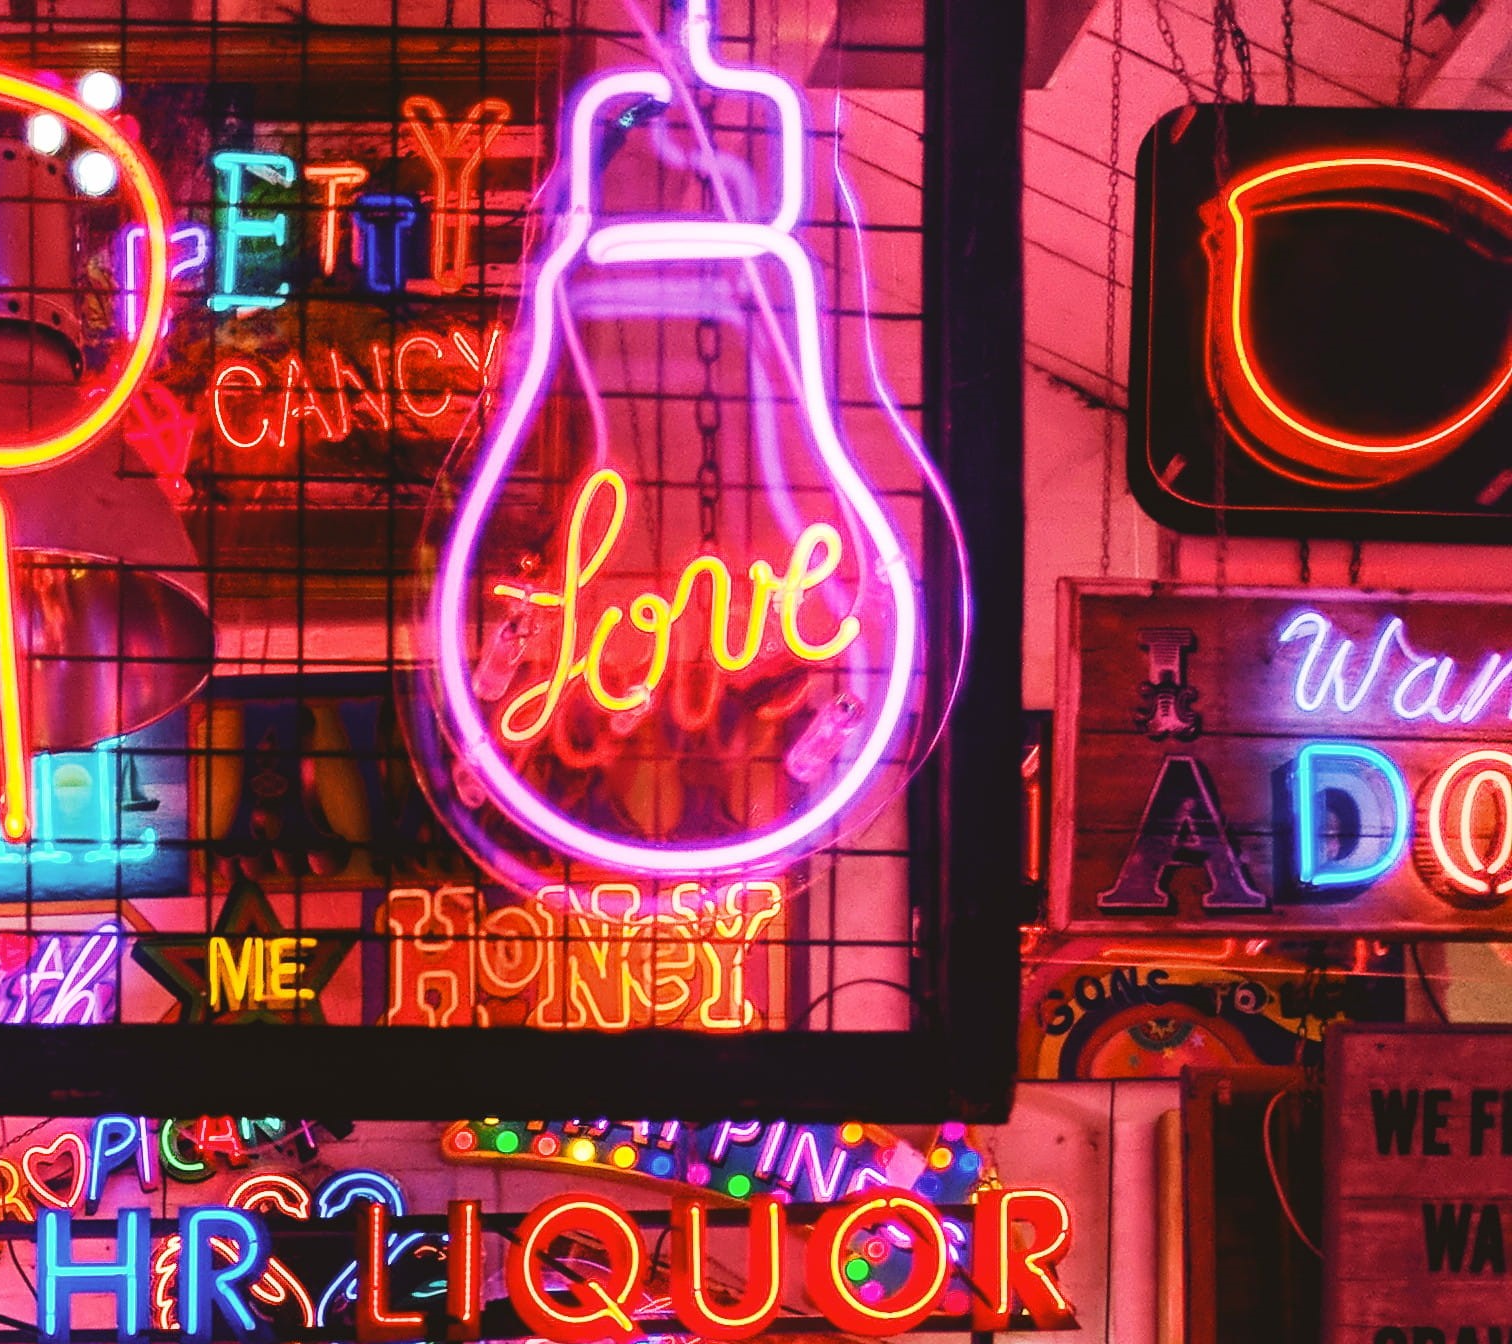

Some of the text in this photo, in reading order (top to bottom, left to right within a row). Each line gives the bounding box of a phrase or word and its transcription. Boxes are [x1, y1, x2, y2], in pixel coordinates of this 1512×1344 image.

[494, 469, 861, 742] Love
[209, 936, 317, 1008] ME
[387, 880, 782, 1029] HONEY
[1370, 1088, 1452, 1156] WE
[357, 1188, 1082, 1344] LIQUOR
